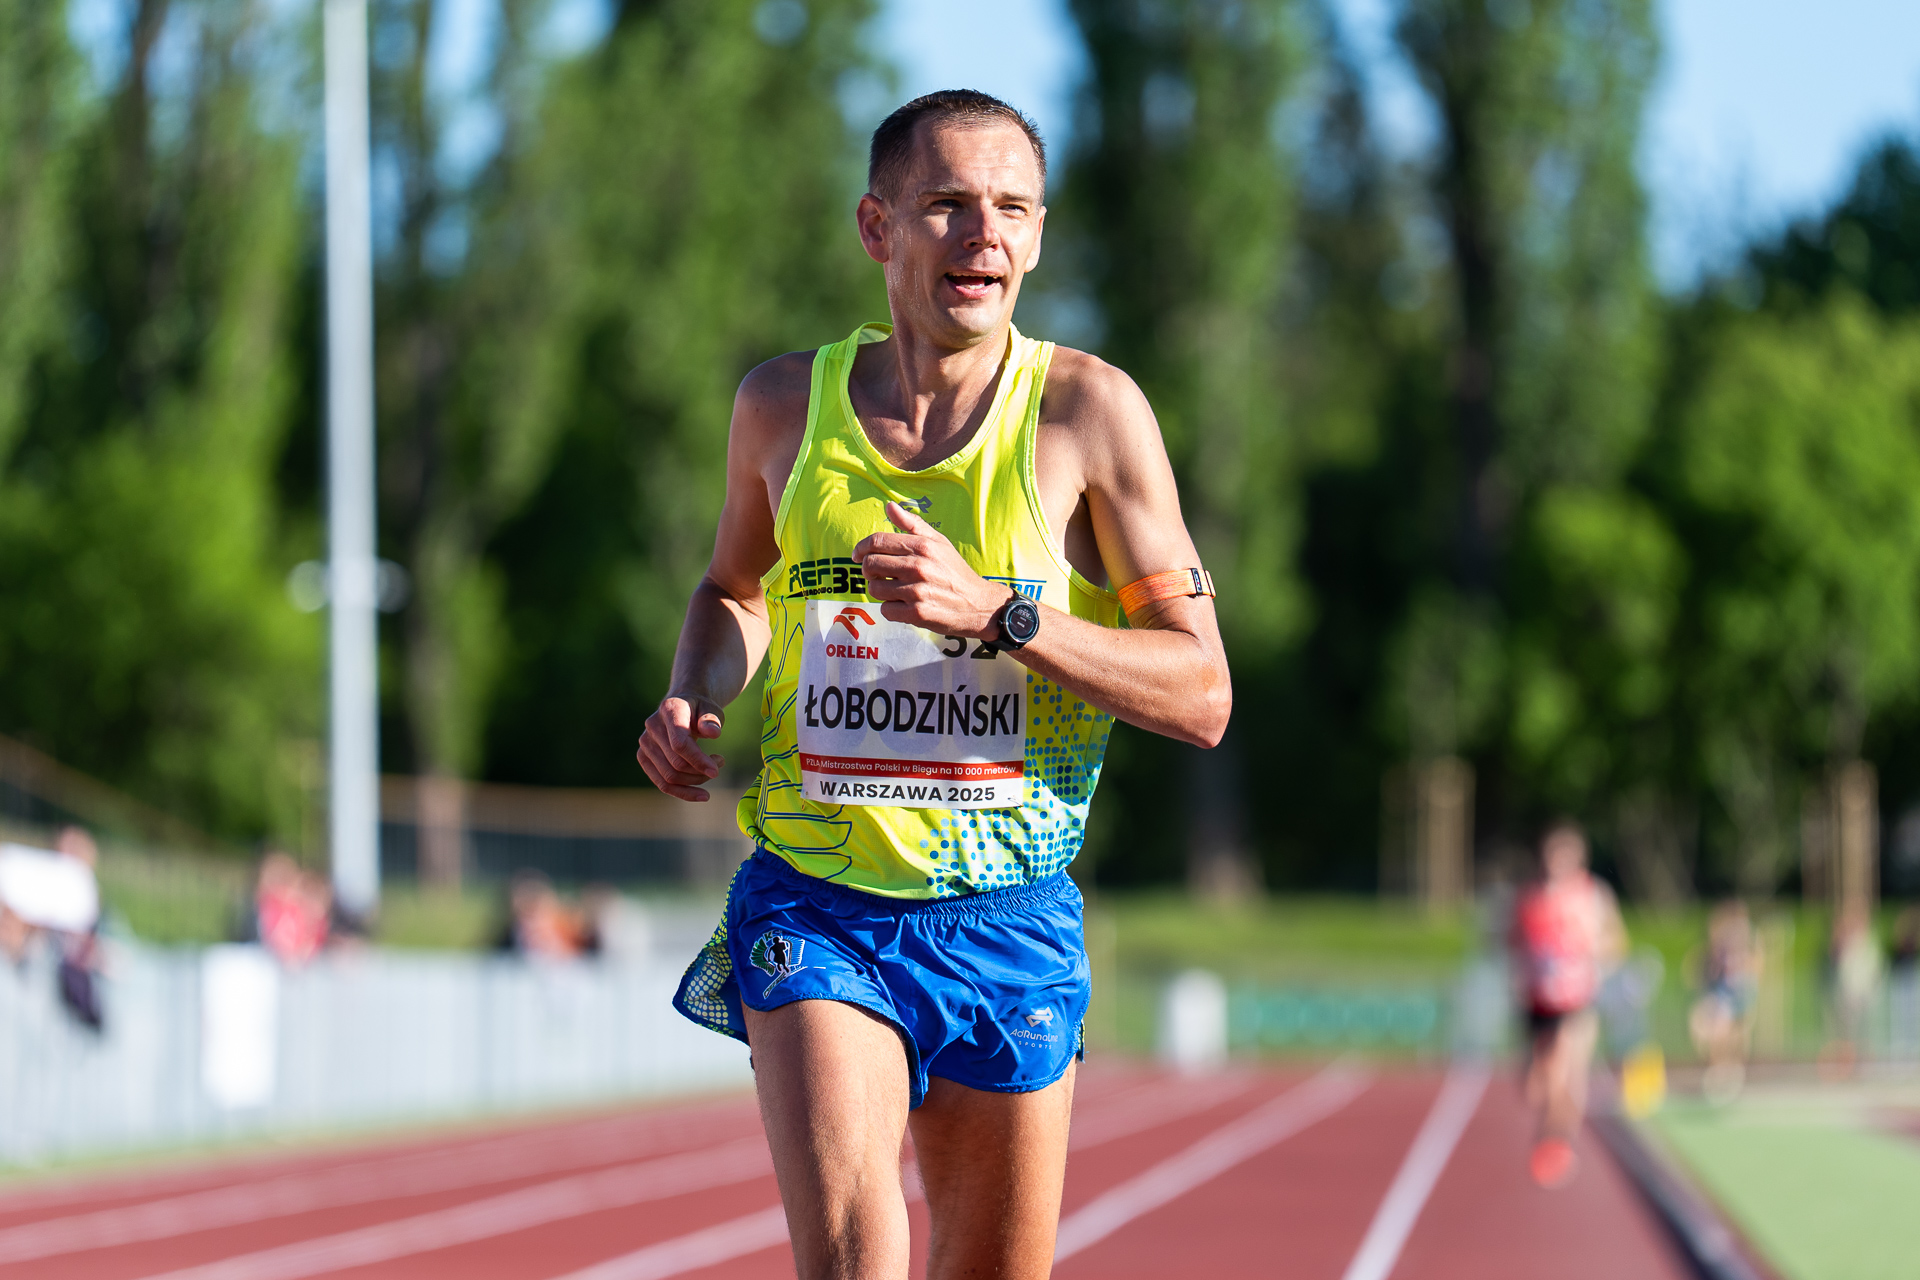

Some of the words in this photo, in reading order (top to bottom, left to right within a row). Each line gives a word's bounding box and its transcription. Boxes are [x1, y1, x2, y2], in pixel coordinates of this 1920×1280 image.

[826, 644, 879, 660] ORLEN
[804, 684, 1019, 736] ŁOBODZIŃSKI
[806, 757, 820, 767] PZLA
[820, 760, 873, 771] Mistrzostwa
[874, 763, 901, 772] Polski
[912, 764, 938, 776] Biegu
[940, 766, 952, 775] na
[954, 766, 963, 775] 10
[965, 767, 983, 776] 000
[984, 765, 1017, 775] metrów
[820, 780, 943, 801] WARSZAWA
[947, 786, 995, 802] 2025
[1018, 1040, 1052, 1050] SPORTS
